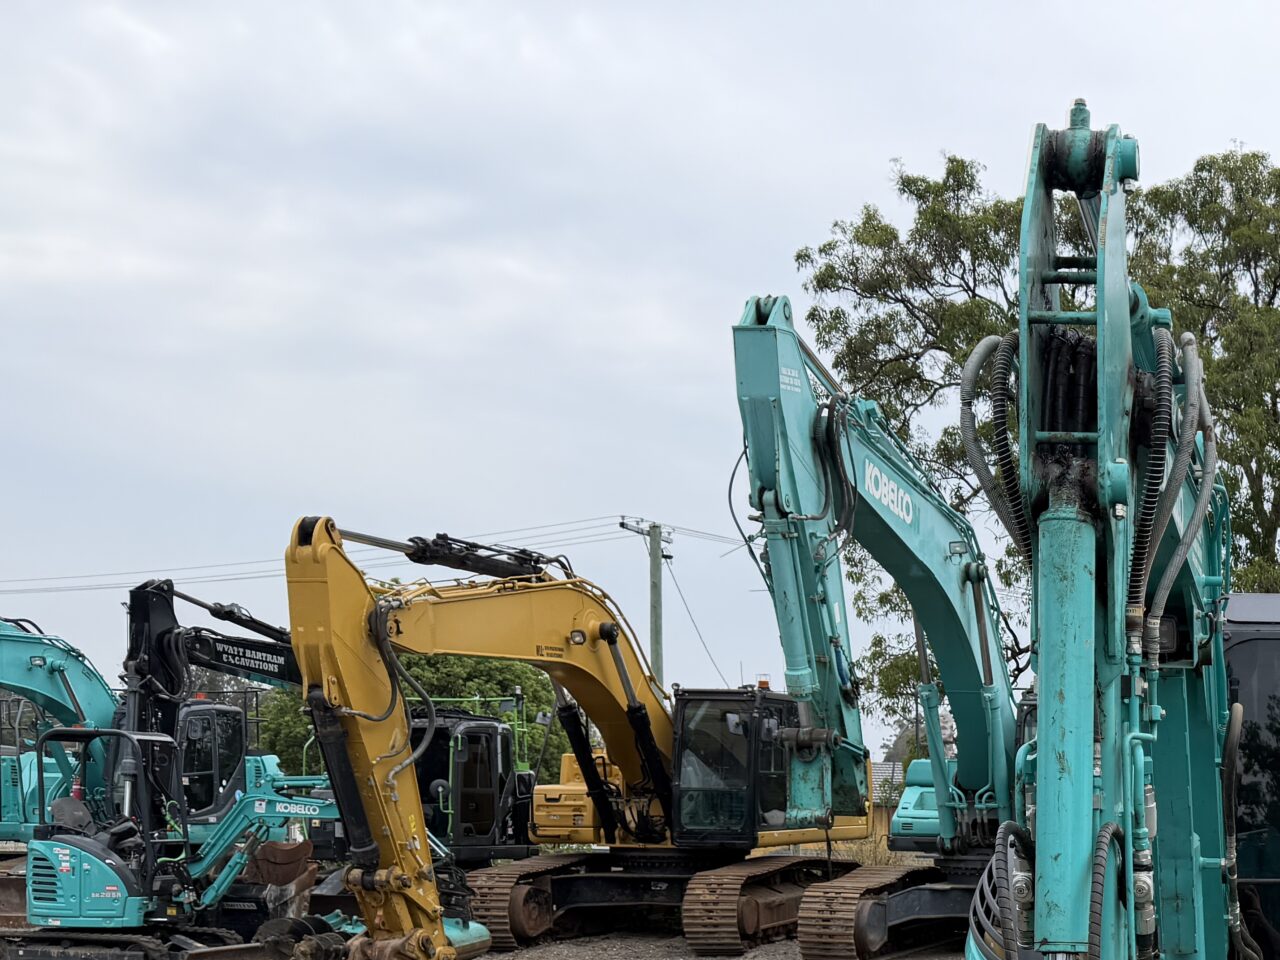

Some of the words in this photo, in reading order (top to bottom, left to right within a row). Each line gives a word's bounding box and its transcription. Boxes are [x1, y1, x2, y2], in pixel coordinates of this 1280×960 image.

[865, 458, 913, 525] KOBELCO
[215, 642, 244, 657] WYATT
[245, 648, 285, 665] BARTRAM
[275, 801, 320, 816] KOBELCO
